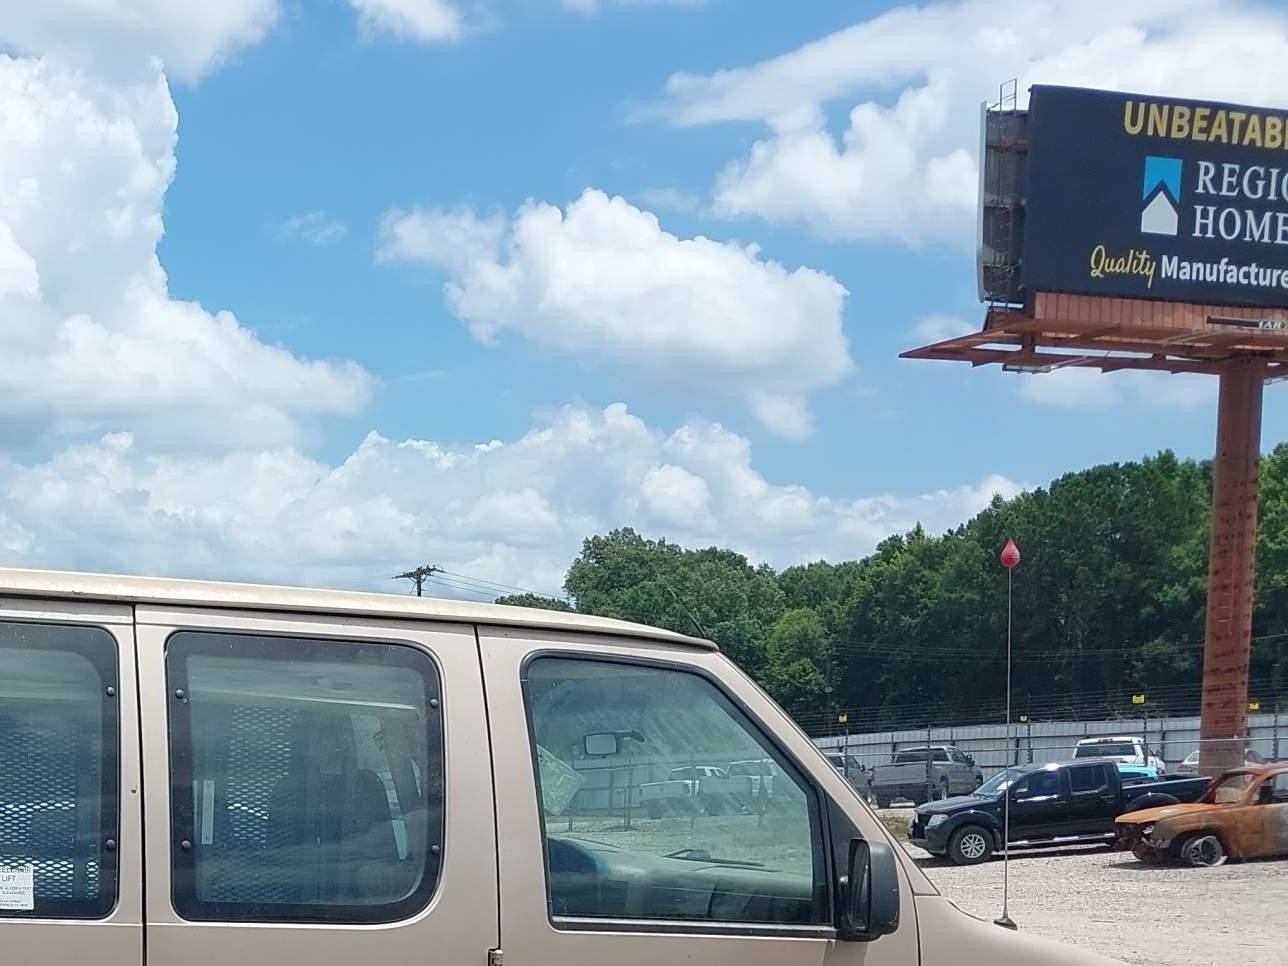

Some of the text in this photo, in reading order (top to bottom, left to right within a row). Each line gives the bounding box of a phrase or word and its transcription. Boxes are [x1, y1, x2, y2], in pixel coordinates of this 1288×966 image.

[1192, 205, 1288, 245] HOME
[1090, 245, 1288, 289] Quality Manufacture
[1, 875, 17, 883] LIFT
